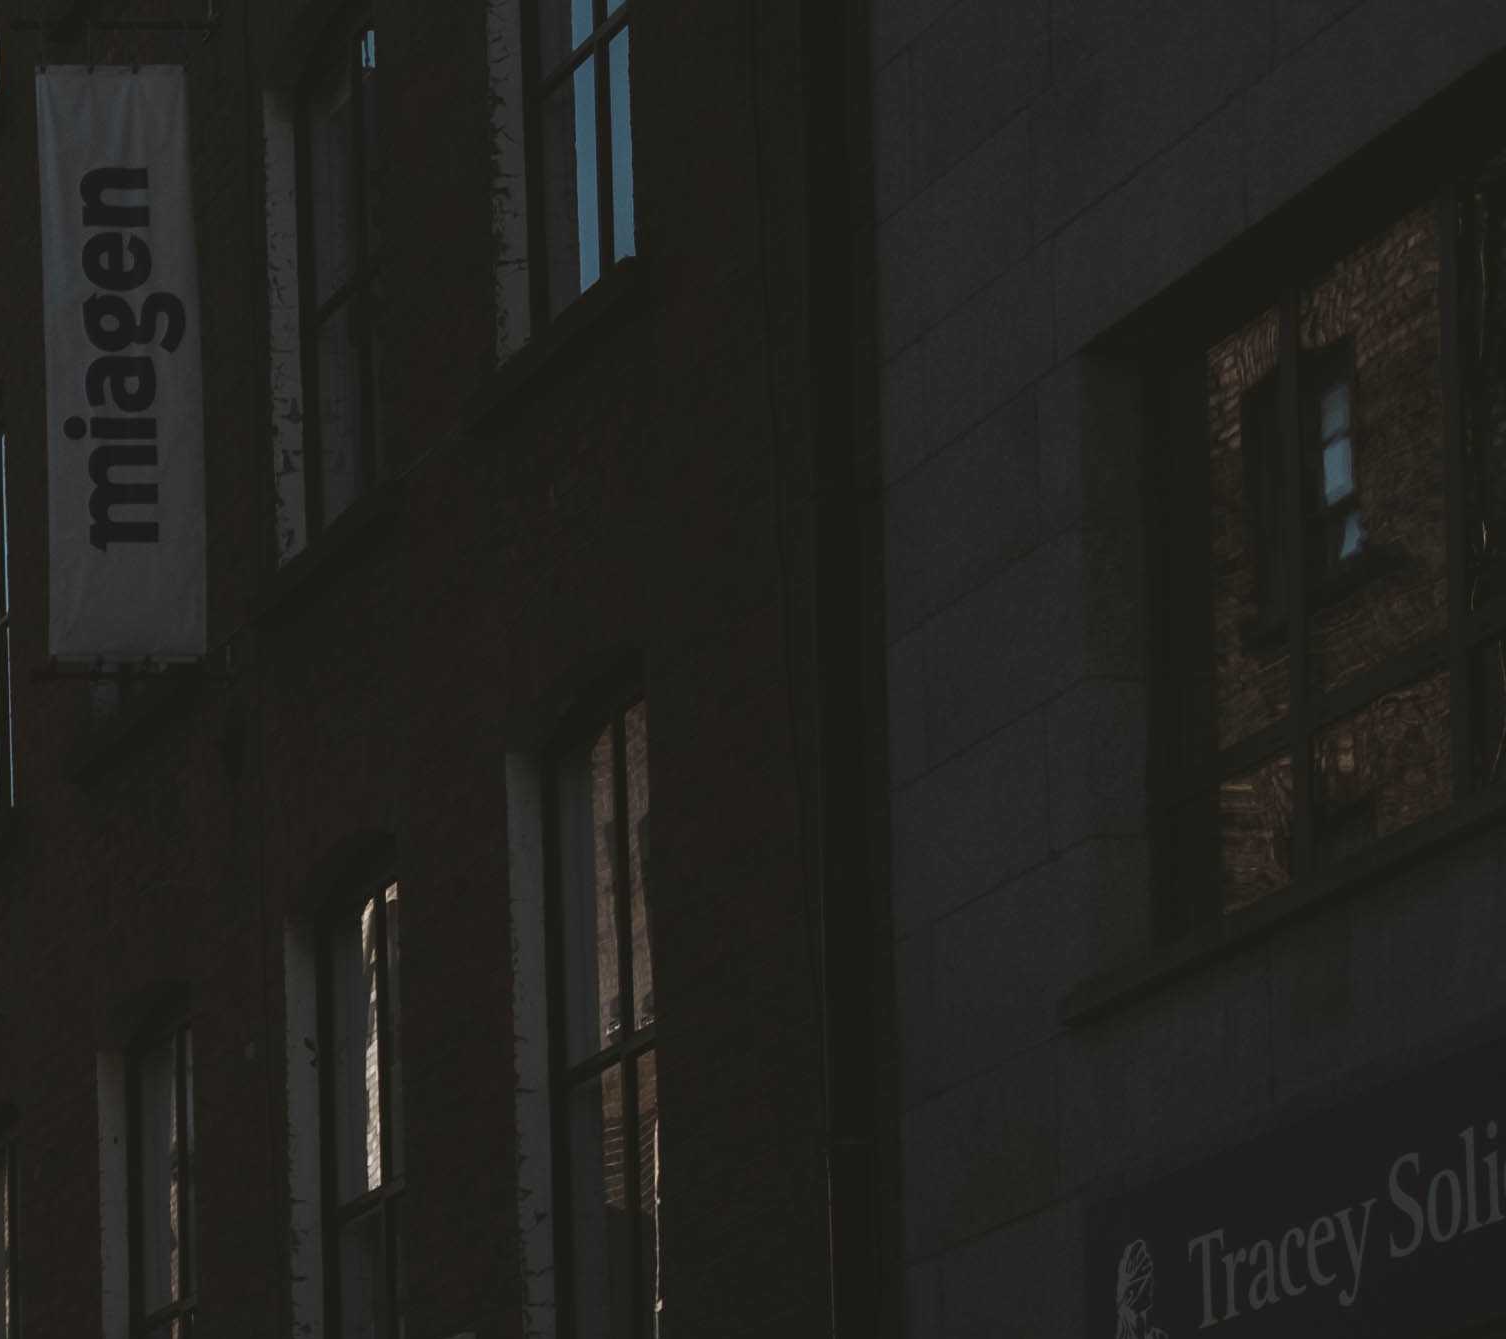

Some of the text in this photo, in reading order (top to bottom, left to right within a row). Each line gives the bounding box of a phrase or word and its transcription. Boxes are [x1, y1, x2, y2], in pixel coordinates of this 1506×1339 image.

[62, 165, 187, 553] miagen
[1186, 1119, 1506, 1329] Tracey Soli
